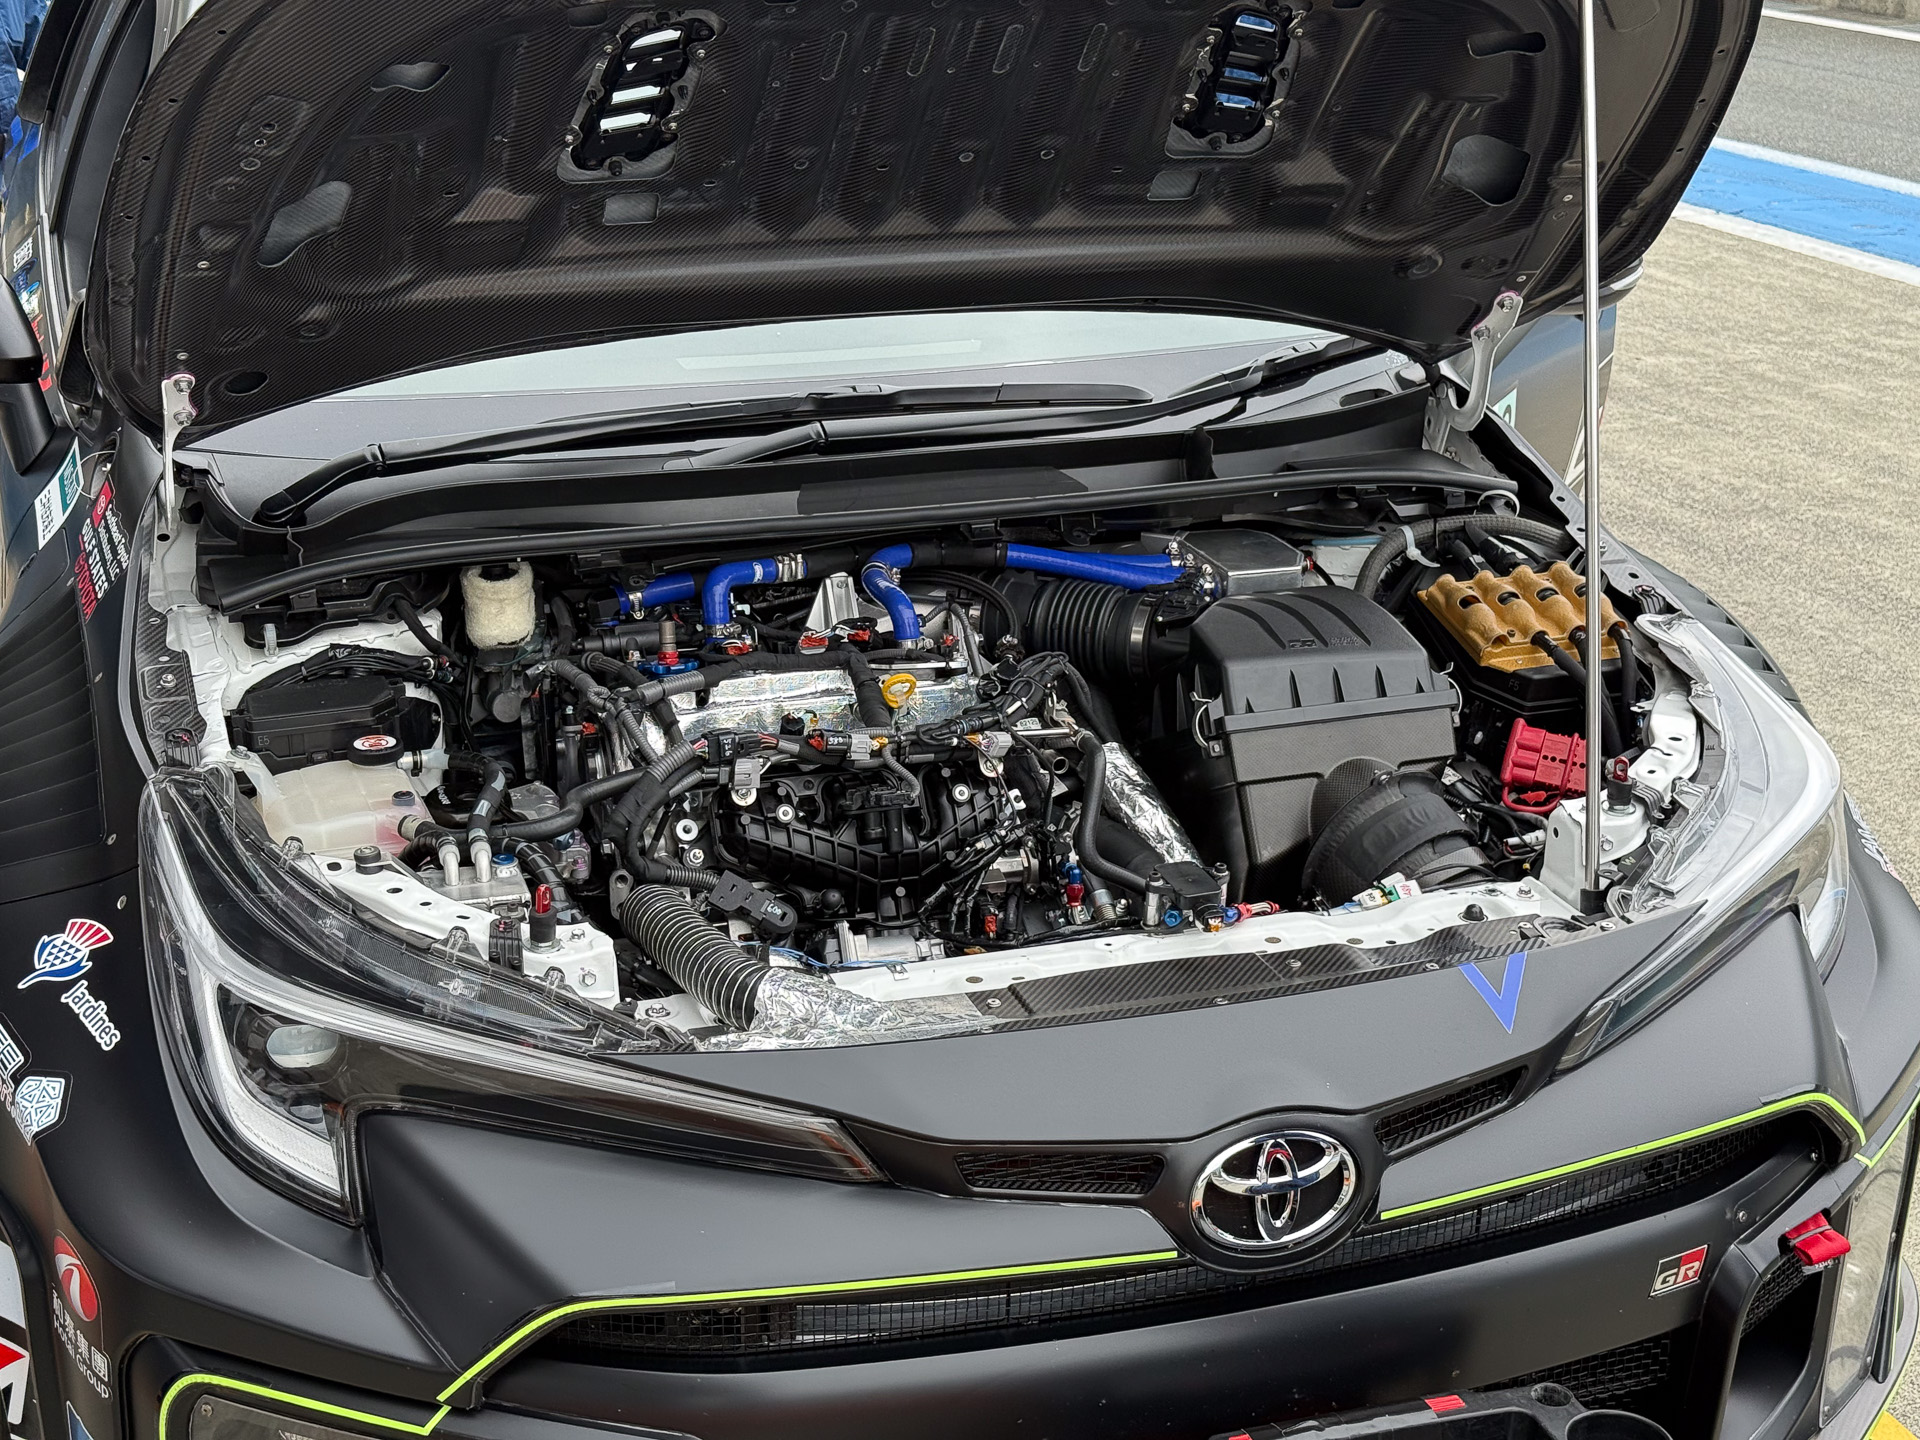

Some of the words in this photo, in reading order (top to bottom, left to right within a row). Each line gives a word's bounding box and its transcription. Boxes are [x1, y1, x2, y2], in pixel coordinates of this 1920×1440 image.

[82, 517, 96, 553] GULF
[89, 547, 108, 599] STATES
[105, 503, 121, 544] Southeast
[116, 538, 129, 570] Toyota
[77, 563, 97, 619] TOYOTA
[257, 735, 270, 746] E5
[62, 981, 120, 1050] Jardines
[1655, 1261, 1701, 1291] GR
[54, 1314, 75, 1359] Hotai
[76, 1355, 109, 1399] Group
